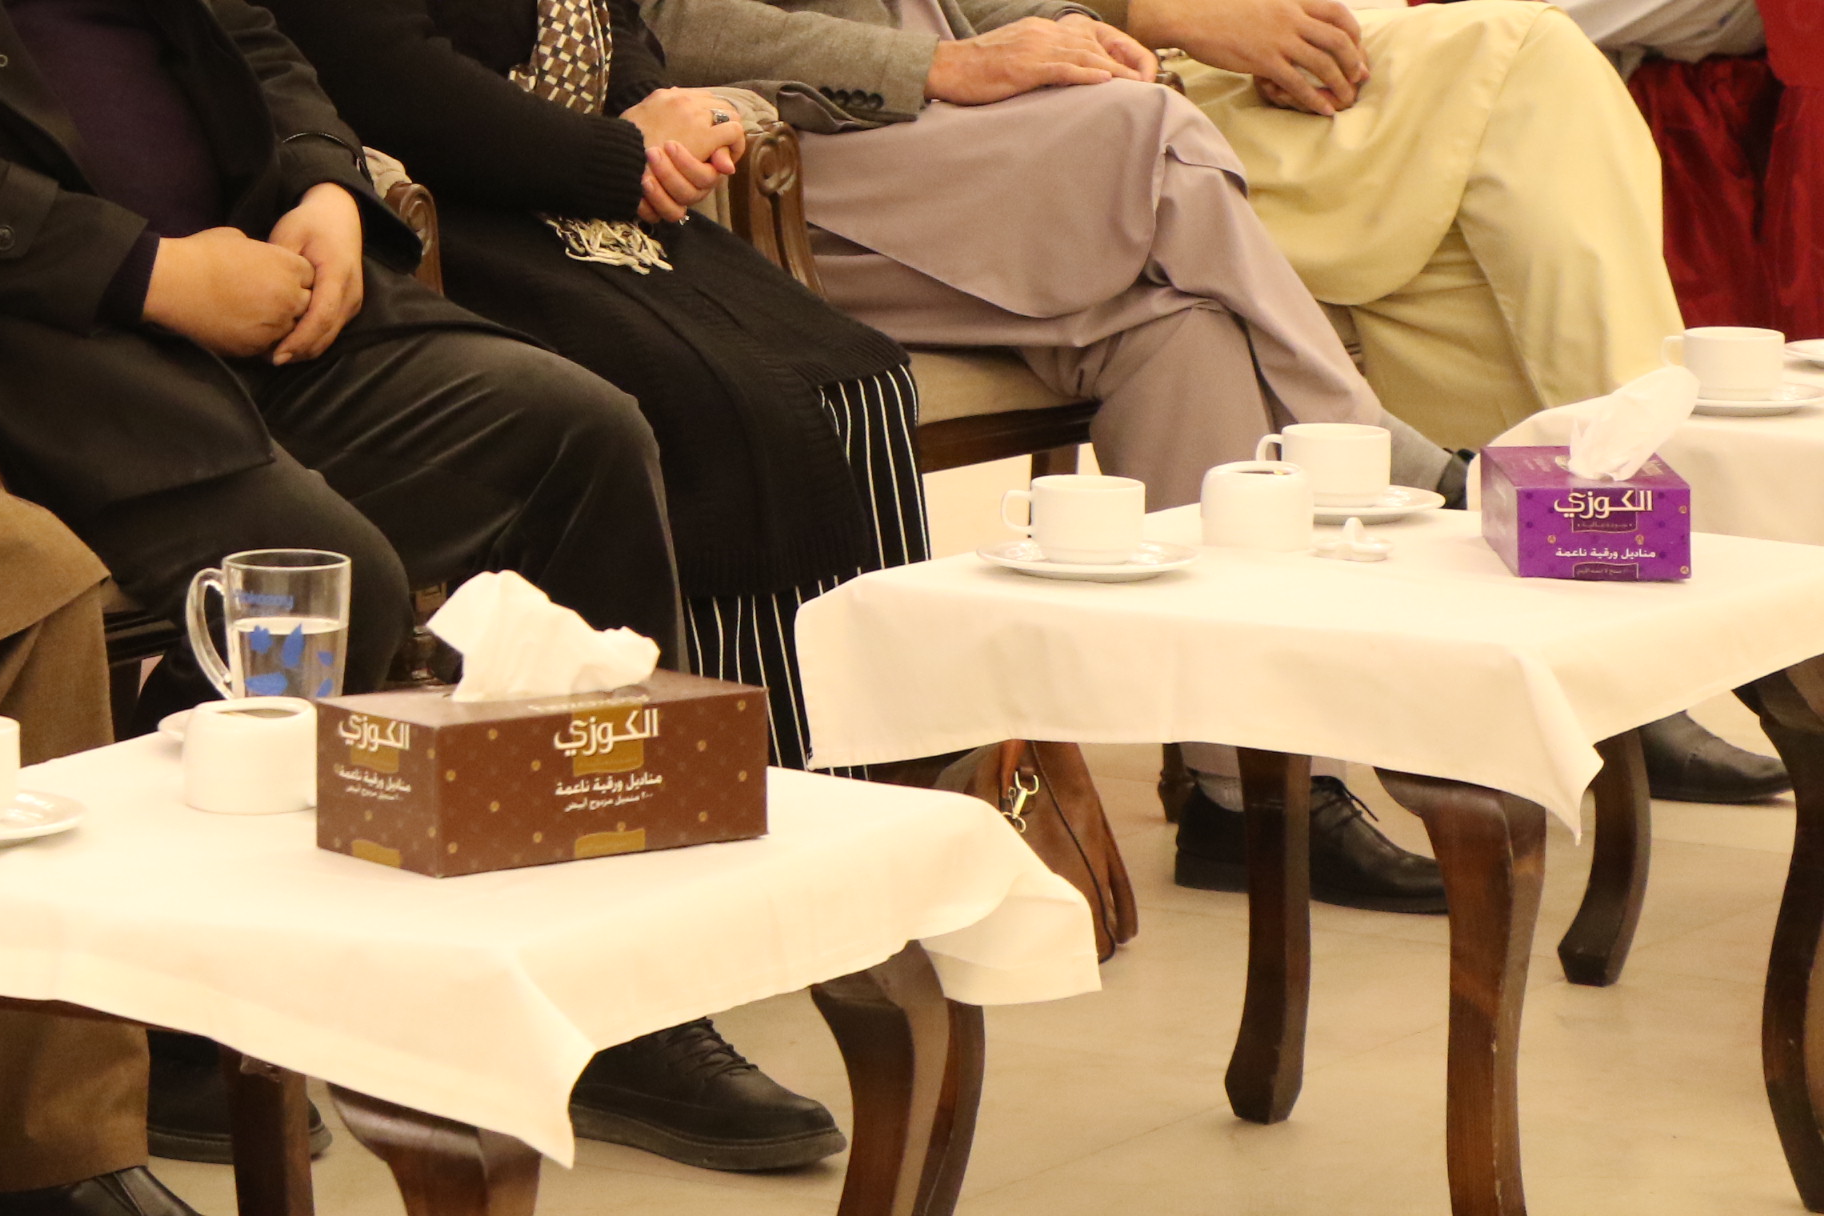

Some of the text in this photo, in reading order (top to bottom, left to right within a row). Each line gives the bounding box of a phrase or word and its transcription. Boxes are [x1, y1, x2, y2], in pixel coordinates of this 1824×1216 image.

[1554, 489, 1654, 520] الكوزي
[1555, 547, 1656, 559] مناديل ورقية ناعمة
[337, 714, 411, 753] الكوزي
[553, 707, 659, 757] الكوزي
[554, 771, 663, 796] مناديل ورقية ناعمة
